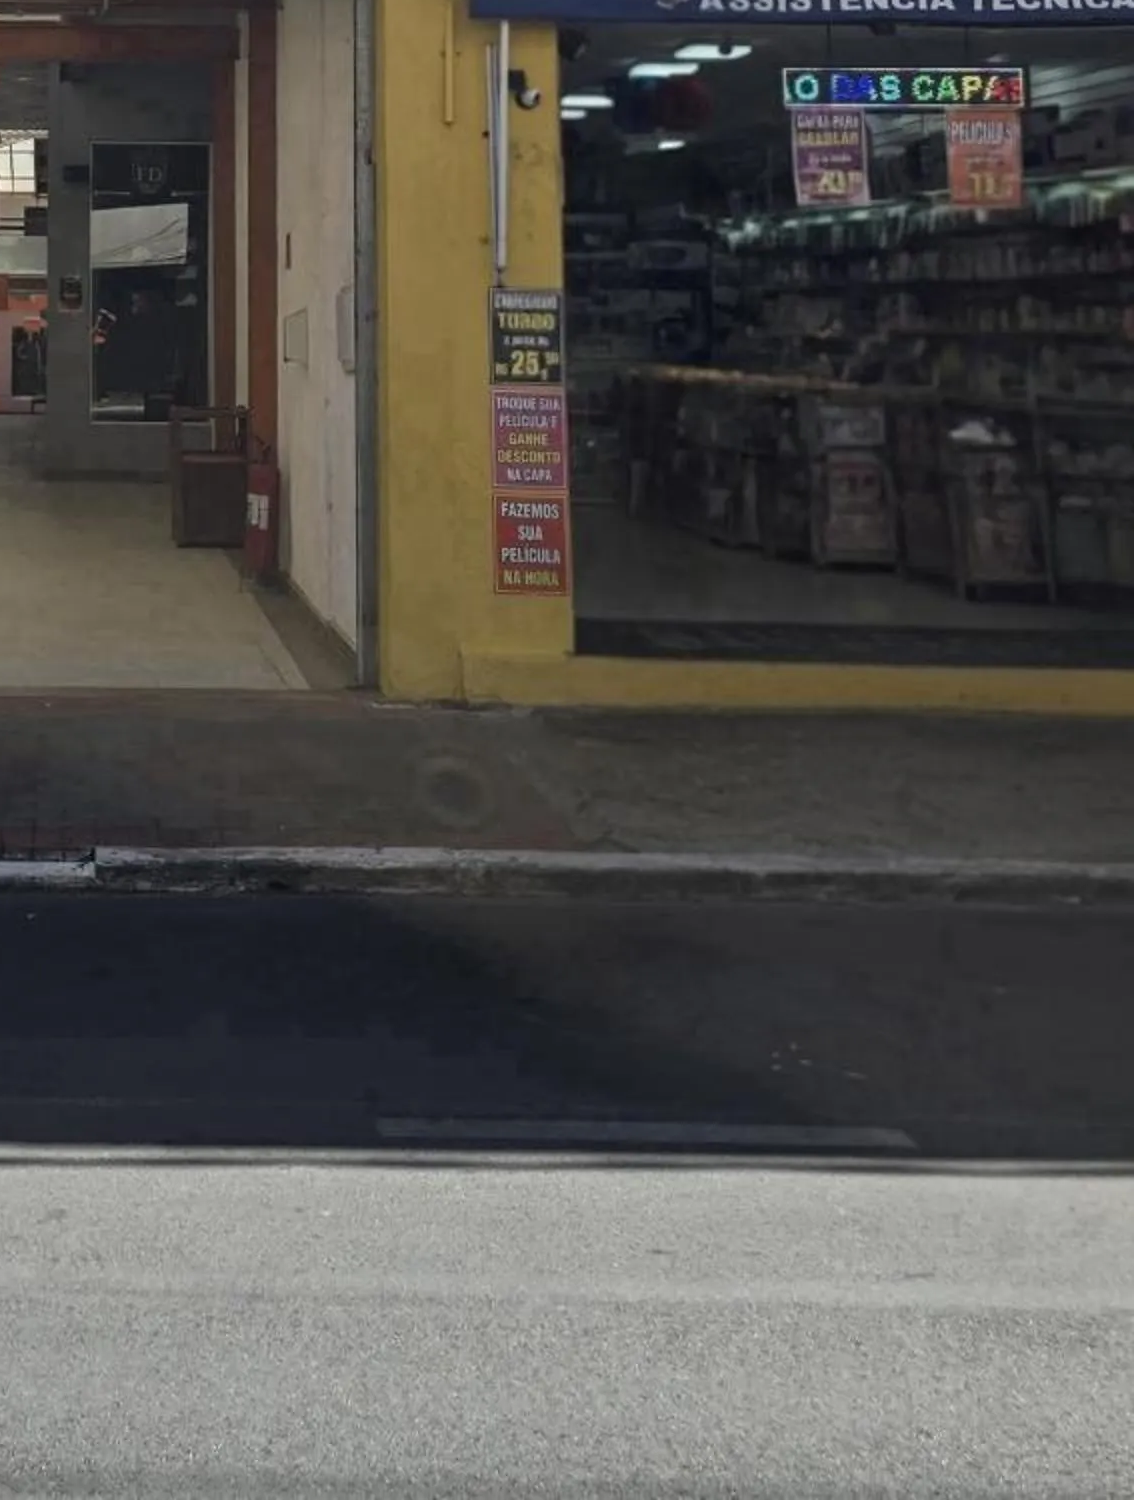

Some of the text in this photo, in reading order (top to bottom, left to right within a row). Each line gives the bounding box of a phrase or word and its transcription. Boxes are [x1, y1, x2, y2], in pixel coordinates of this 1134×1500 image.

[497, 396, 536, 410] TROQUE
[509, 431, 548, 446] GANHE
[497, 449, 561, 464] DESCONTO
[501, 501, 560, 519] FAZEMOS
[517, 524, 543, 541] SUA
